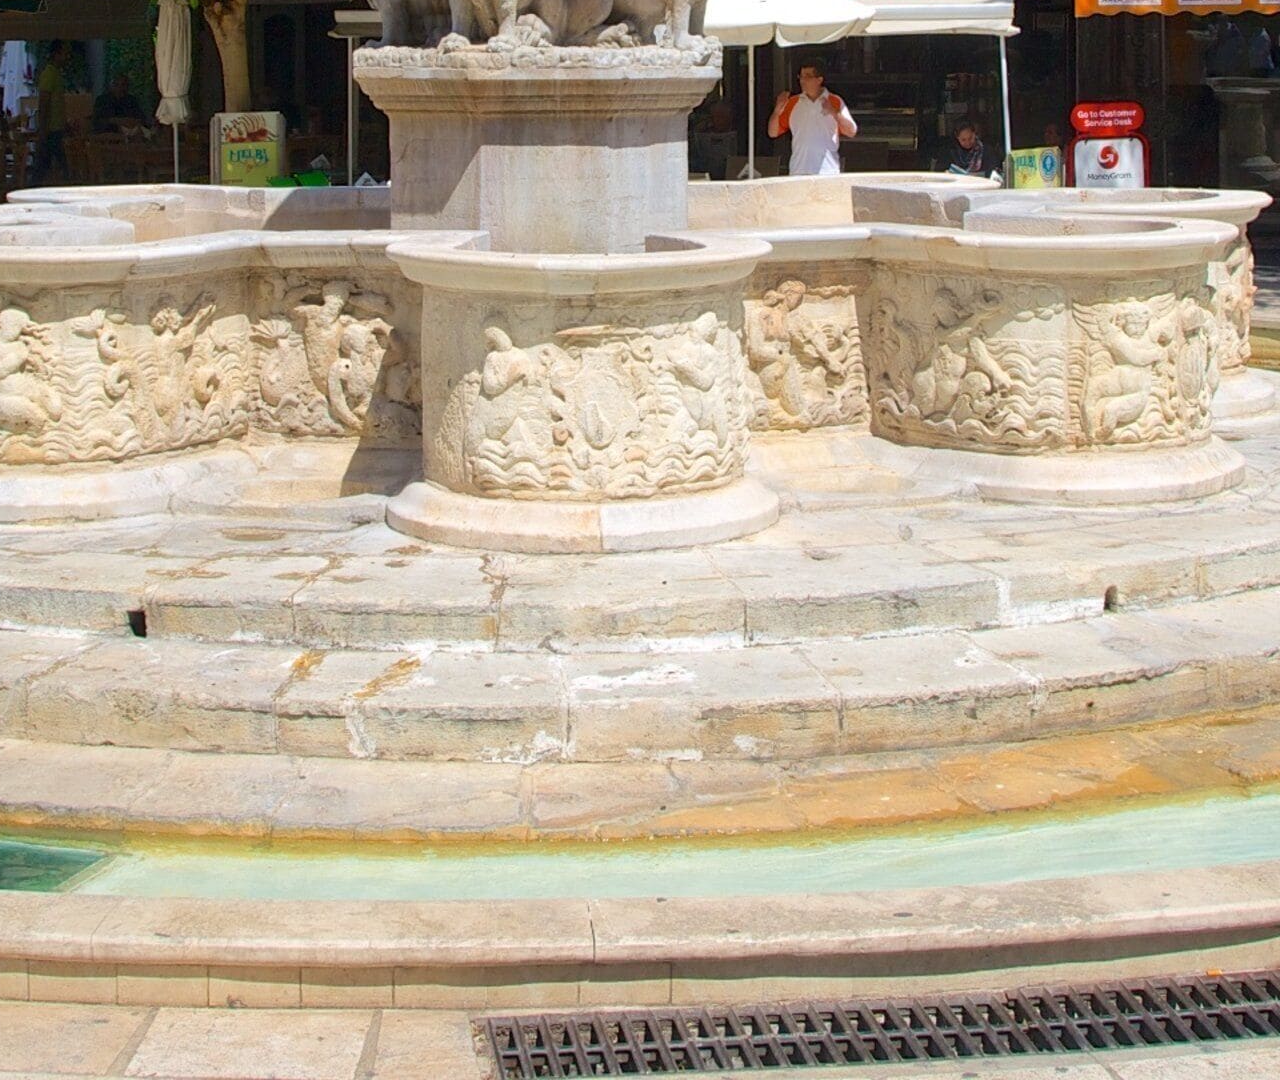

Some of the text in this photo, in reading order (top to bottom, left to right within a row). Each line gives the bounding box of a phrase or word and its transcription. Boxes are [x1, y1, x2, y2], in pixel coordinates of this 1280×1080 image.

[1077, 109, 1137, 119] Go to Customer
[1084, 117, 1133, 127] Service Desk
[1087, 172, 1132, 181] MoneyGram
